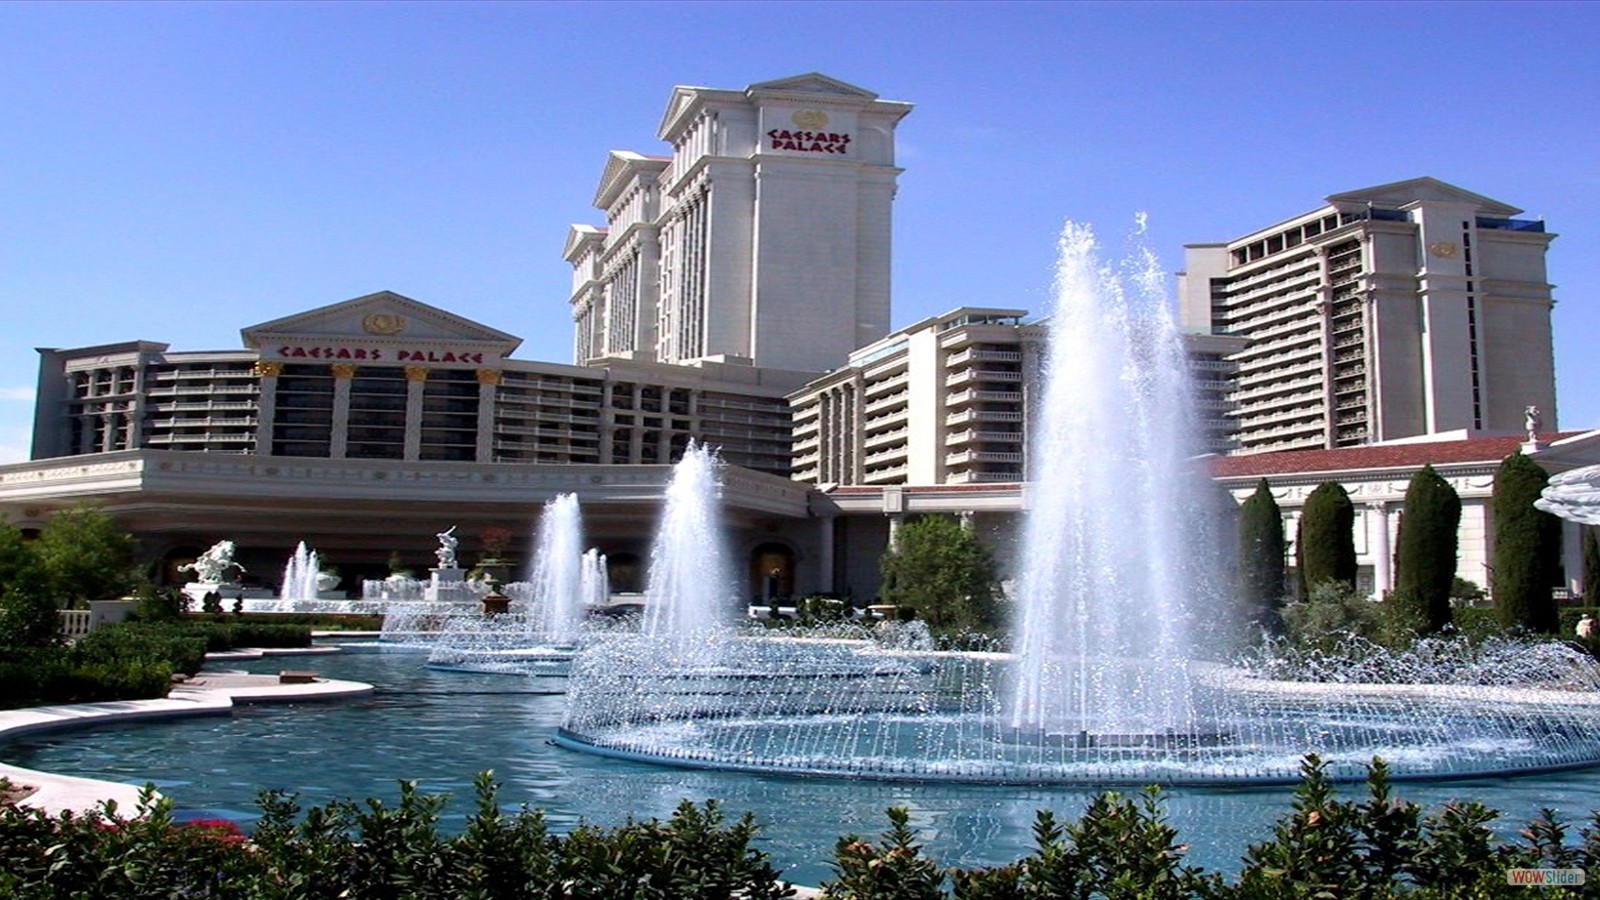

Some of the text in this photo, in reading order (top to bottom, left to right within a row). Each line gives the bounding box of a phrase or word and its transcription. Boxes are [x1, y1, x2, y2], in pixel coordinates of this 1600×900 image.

[767, 129, 851, 144] CAESARS
[772, 140, 846, 154] PALACE
[278, 346, 483, 364] CAESARS PALACE
